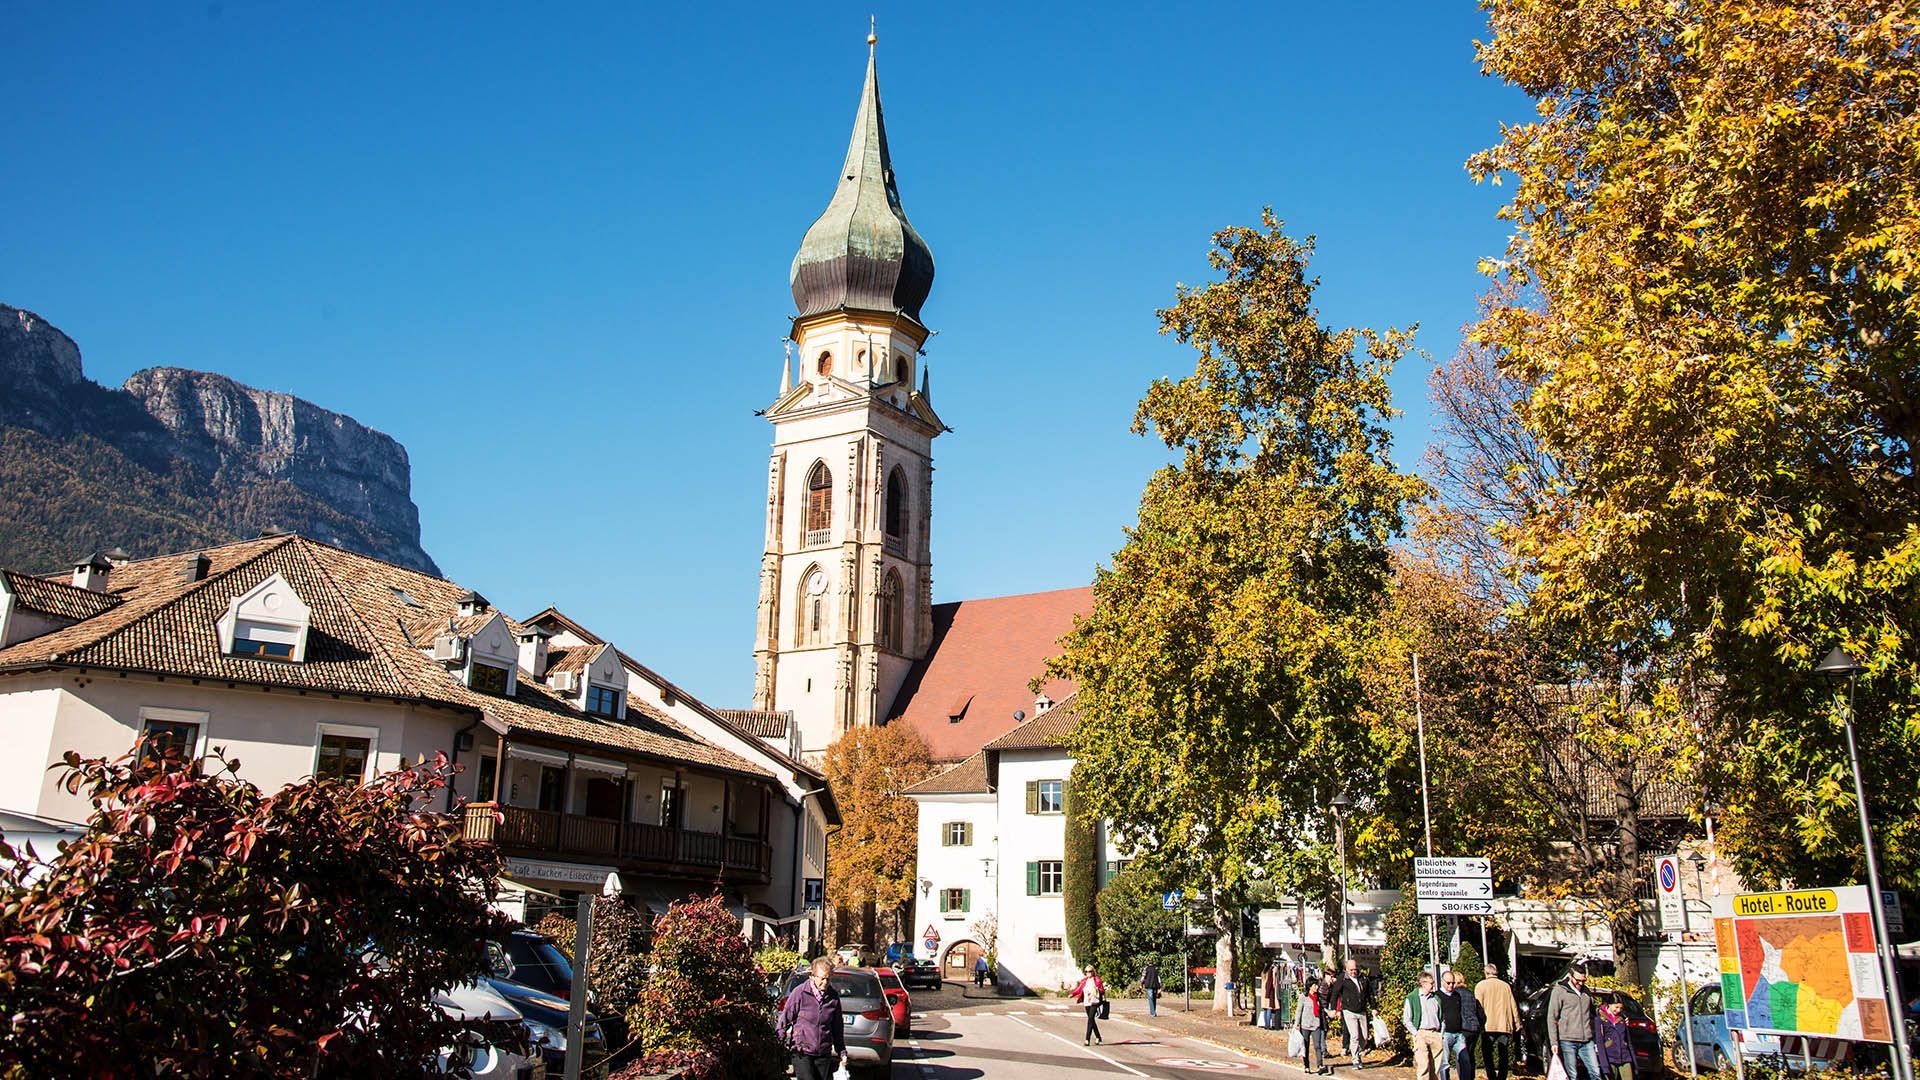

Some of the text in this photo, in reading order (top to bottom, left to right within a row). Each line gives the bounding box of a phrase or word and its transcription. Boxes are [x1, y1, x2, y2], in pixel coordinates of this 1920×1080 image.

[514, 866, 530, 876] Café
[1417, 867, 1456, 875] biblioteca
[1741, 896, 1774, 913] Hotel
[1786, 894, 1827, 911] Route
